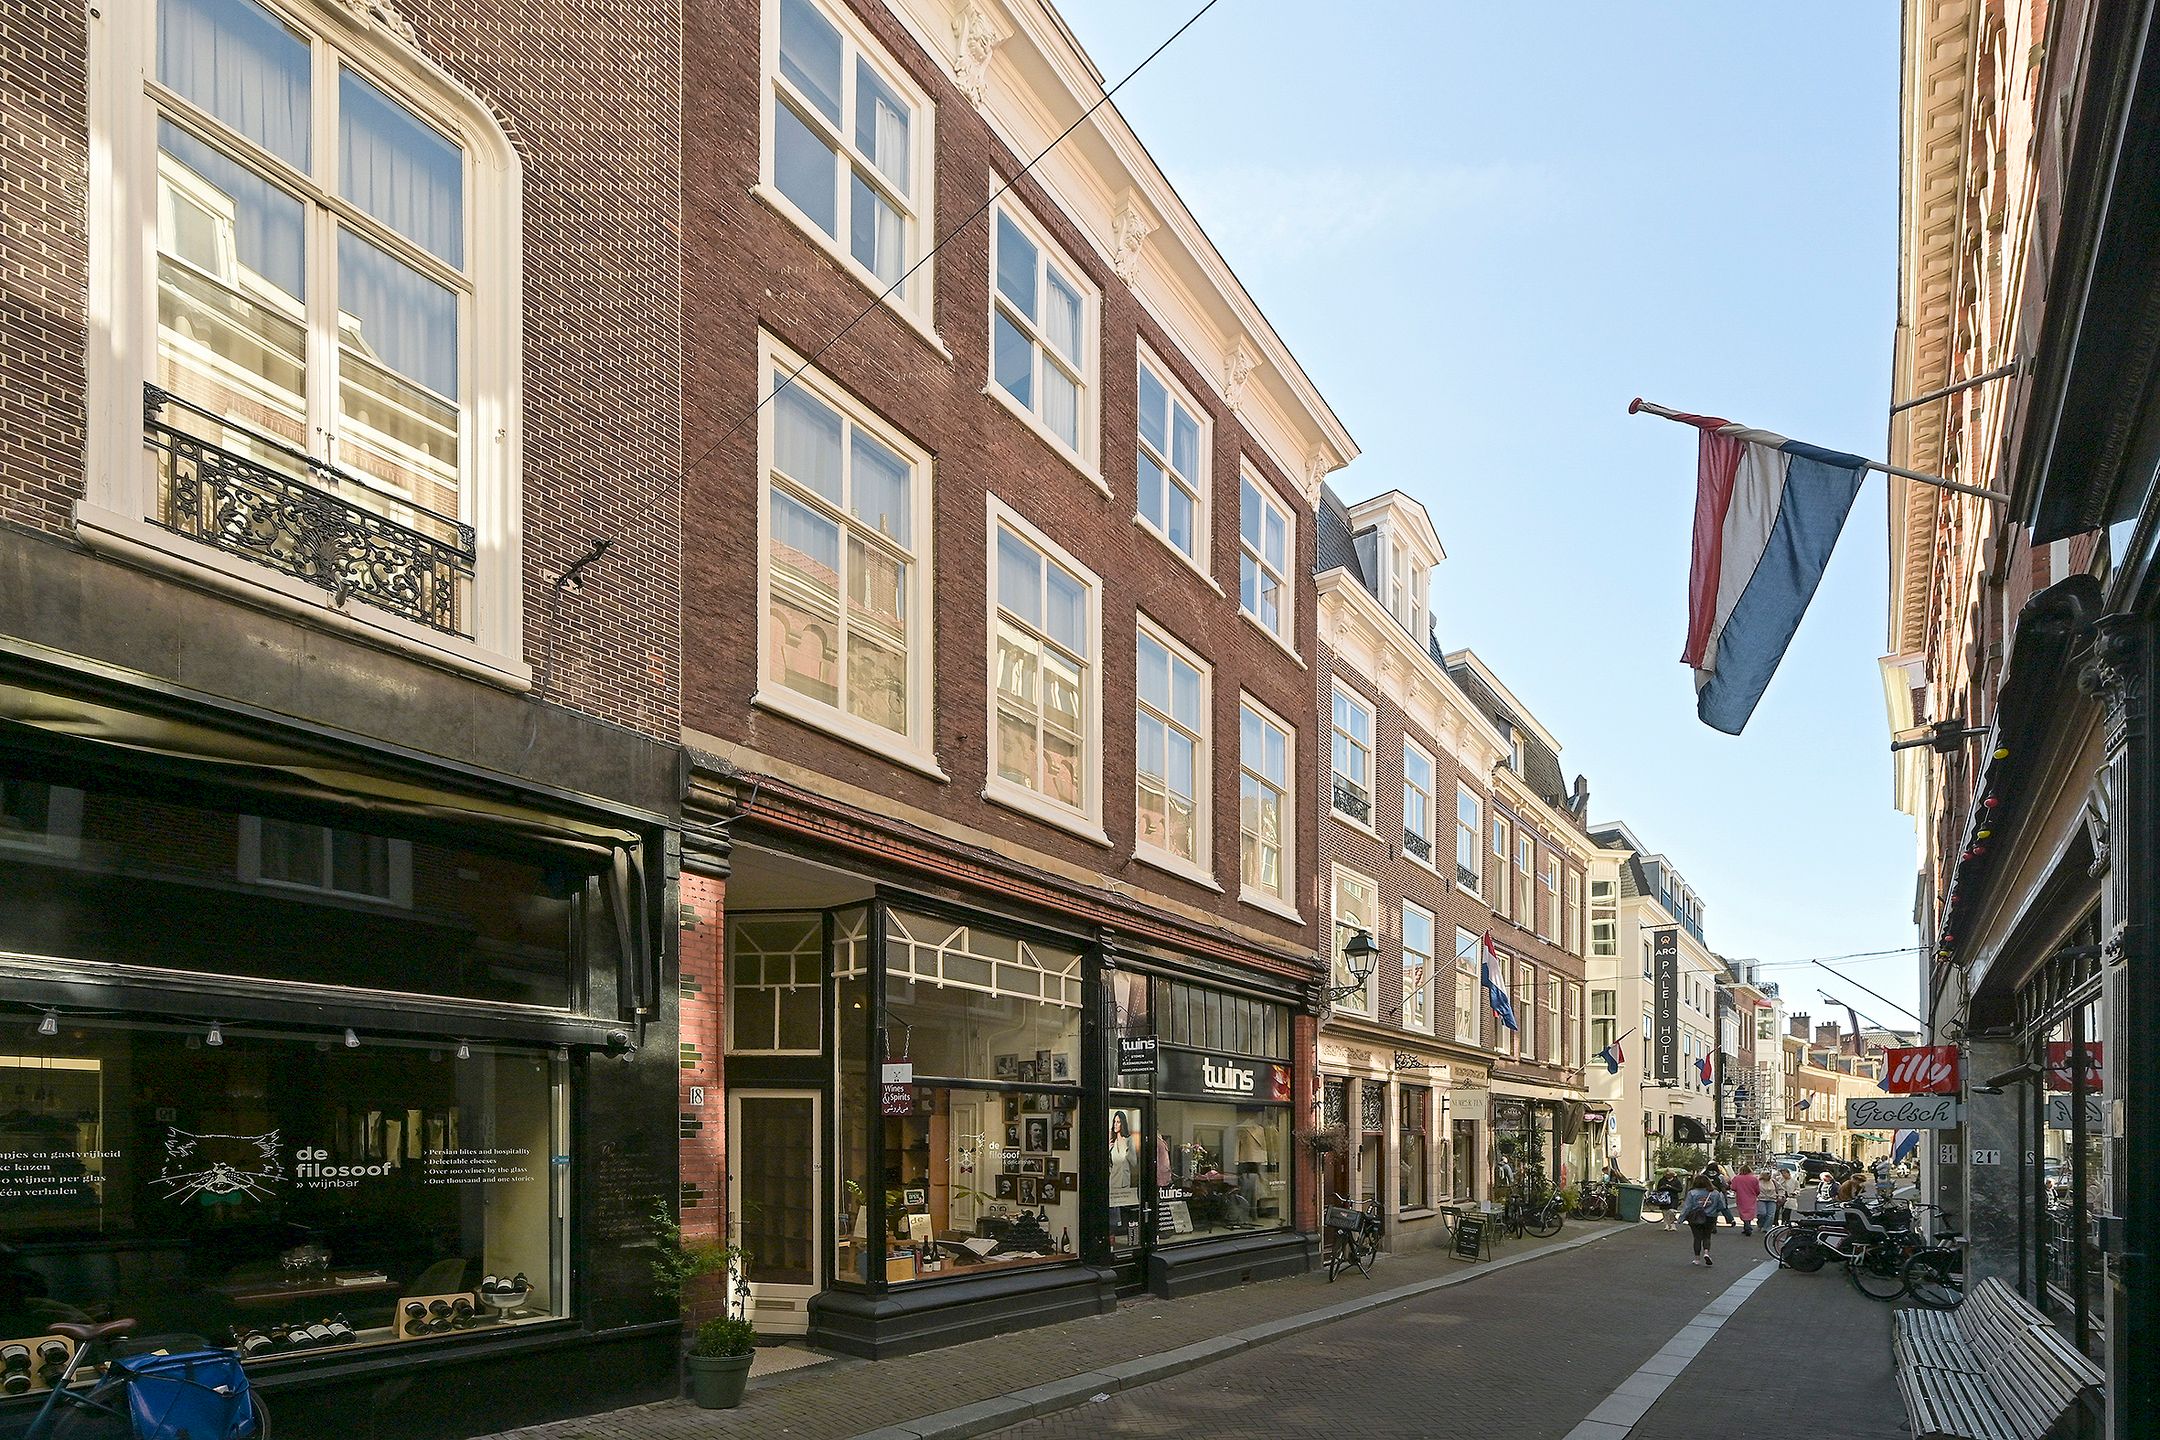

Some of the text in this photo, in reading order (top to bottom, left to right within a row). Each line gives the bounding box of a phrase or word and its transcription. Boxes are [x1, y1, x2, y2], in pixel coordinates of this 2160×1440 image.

[1655, 947, 1677, 956] ARQ
[1660, 961, 1672, 1074] PALEIS HOTEL
[1121, 1038, 1156, 1051] twins
[1202, 1057, 1254, 1091] twins
[1892, 1054, 1952, 1089] illy
[884, 1084, 905, 1092] Wines
[691, 1088, 703, 1105] 18
[882, 1092, 911, 1104] & Spirits
[1851, 1100, 1951, 1127] Grolsch
[988, 1141, 1000, 1150] de
[50, 1150, 121, 1159] gastvrijheid
[296, 1146, 329, 1161] de
[493, 1148, 531, 1156] hospitality
[14, 1163, 51, 1171] kazen
[296, 1161, 391, 1178] filosoof
[487, 1167, 496, 1175] by
[14, 1175, 55, 1184] wijnen
[59, 1176, 80, 1184] per
[82, 1174, 106, 1182] glas
[309, 1178, 360, 1191] wijnbar
[25, 1187, 77, 1195] verhalen
[1158, 1183, 1183, 1199] twins
